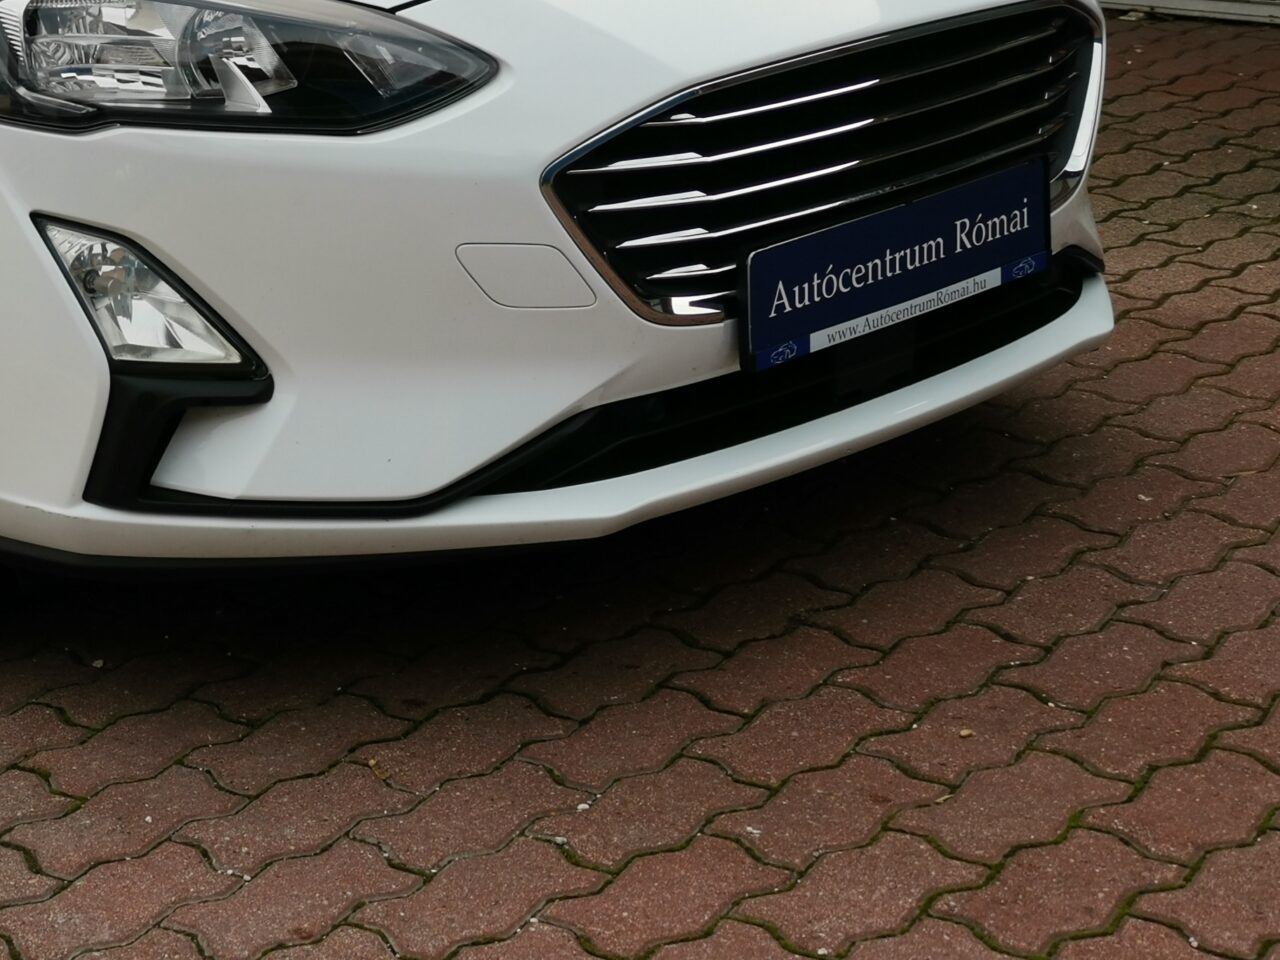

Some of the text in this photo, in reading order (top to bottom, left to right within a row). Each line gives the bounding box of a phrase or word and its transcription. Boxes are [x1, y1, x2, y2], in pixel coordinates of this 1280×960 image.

[768, 197, 1030, 318] Autócentrum Római
[826, 278, 987, 344] www.AutócentrumRómai.hu
